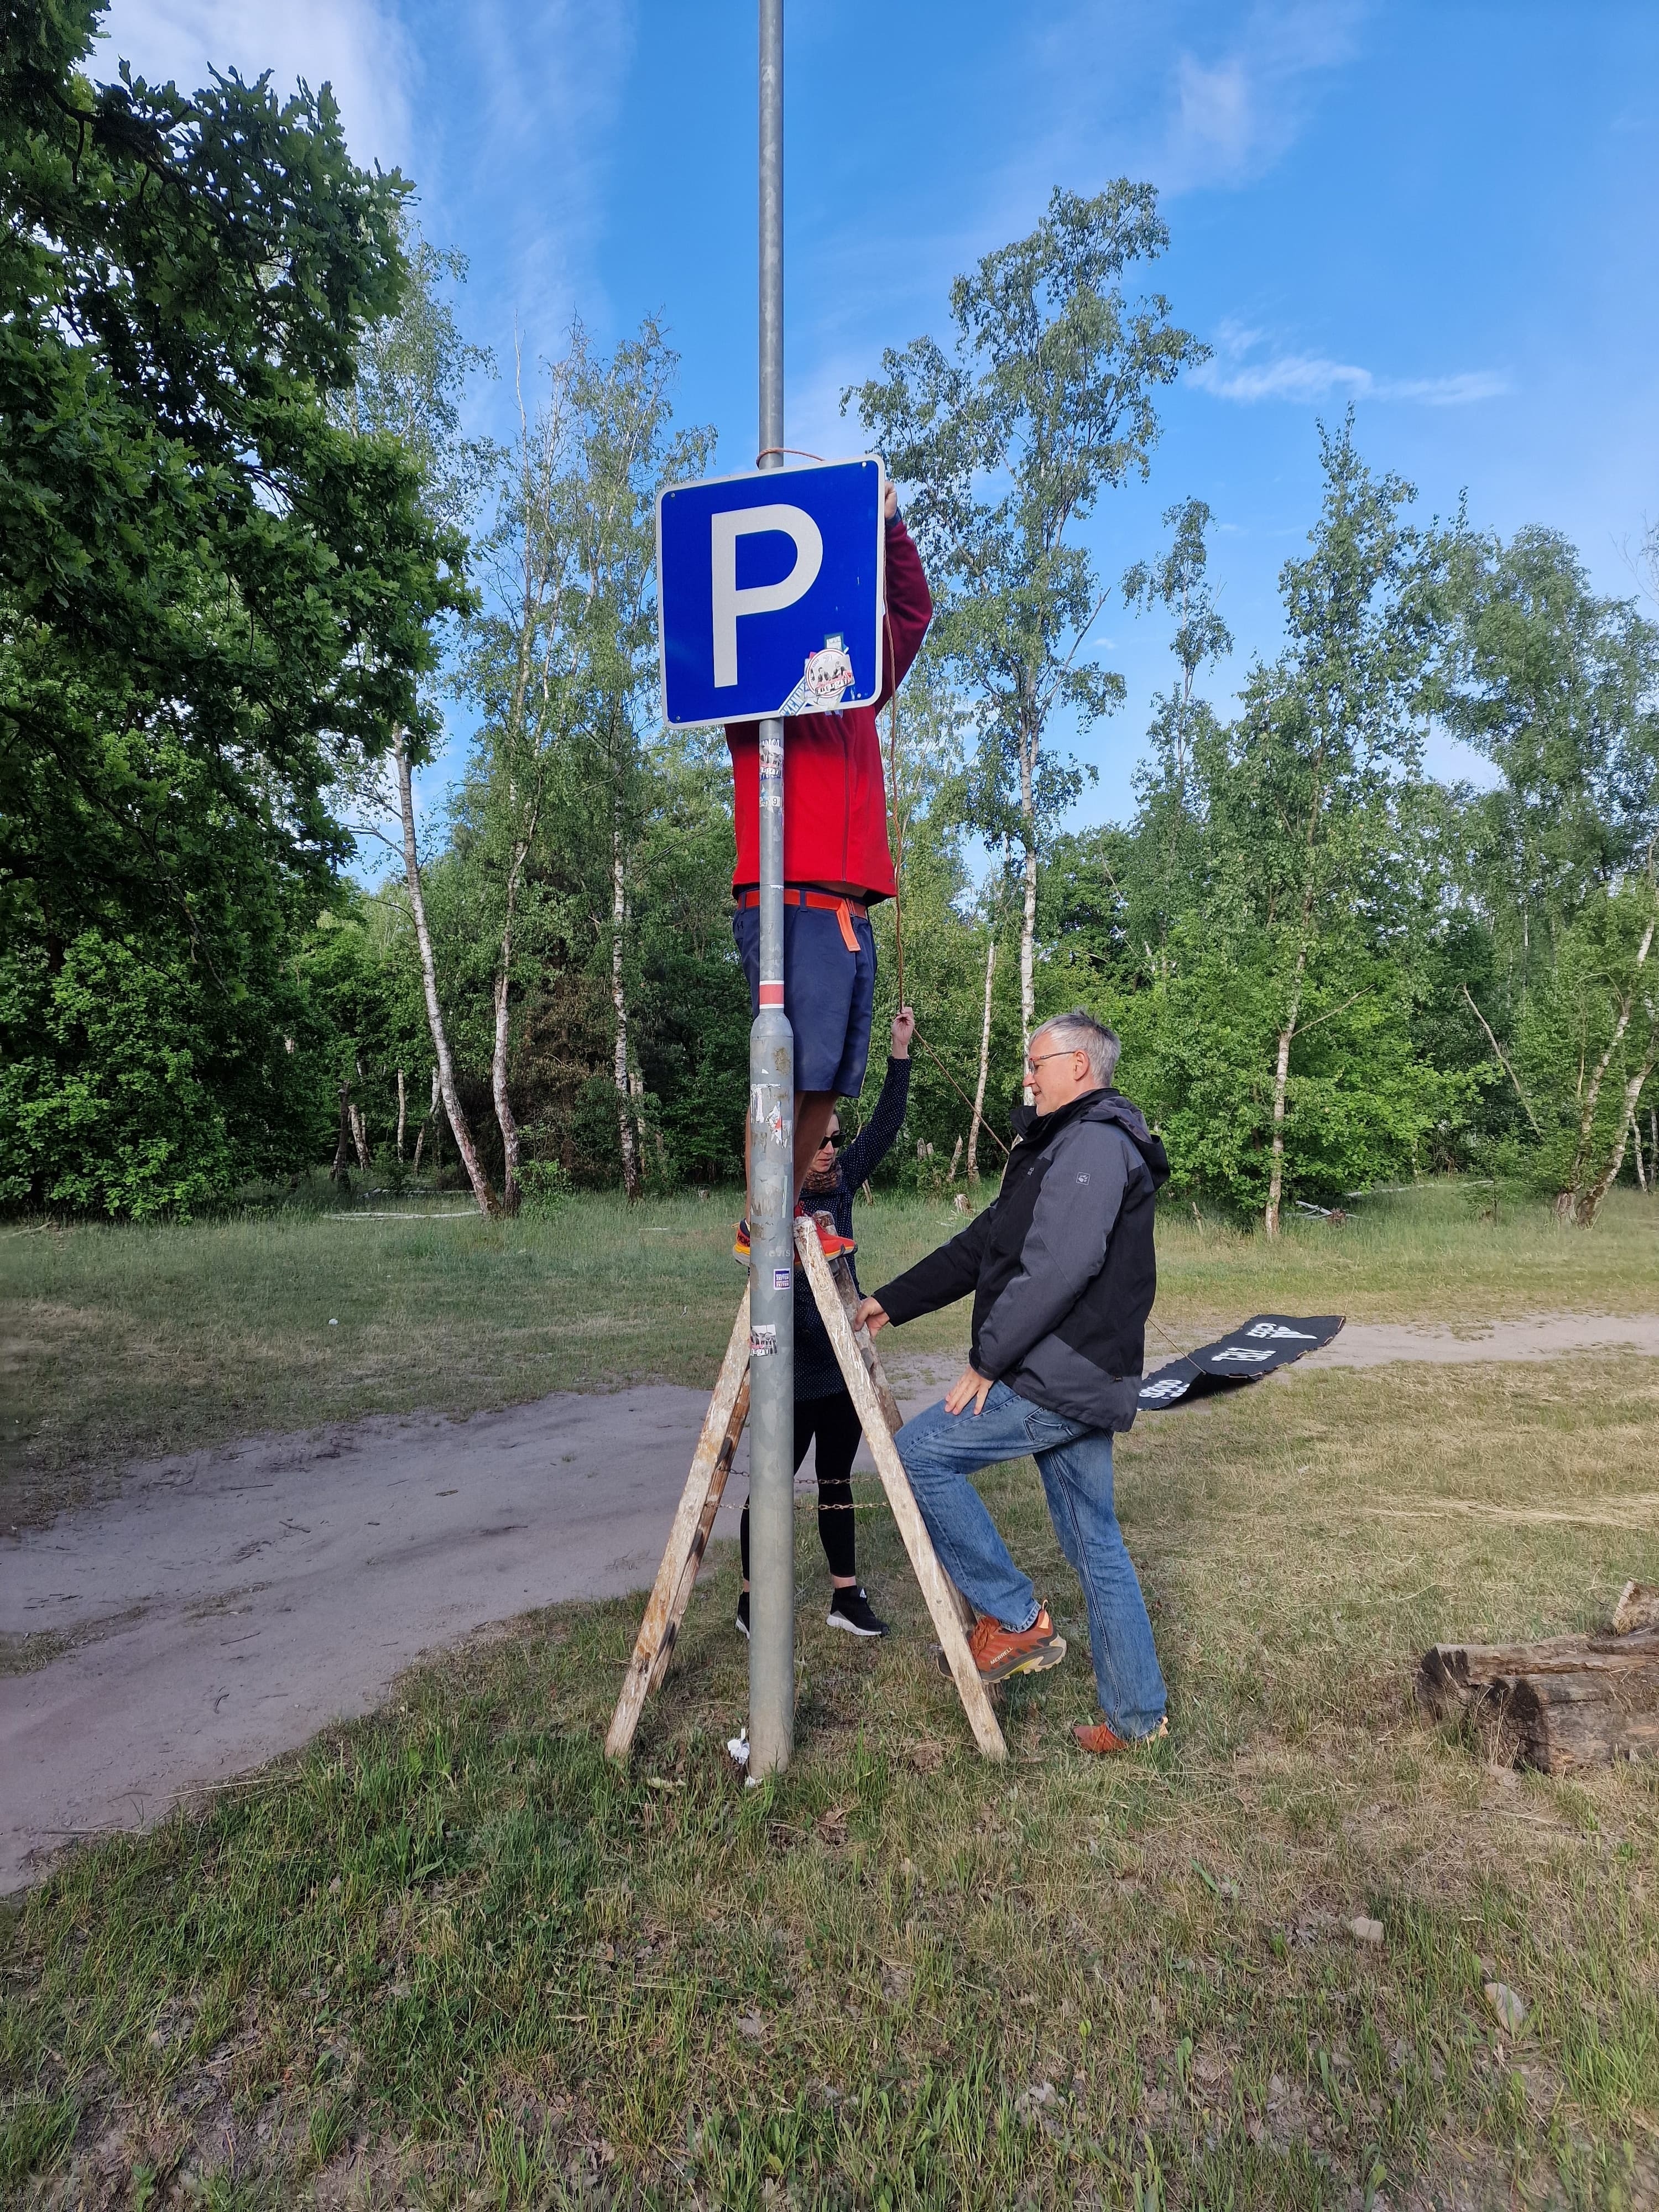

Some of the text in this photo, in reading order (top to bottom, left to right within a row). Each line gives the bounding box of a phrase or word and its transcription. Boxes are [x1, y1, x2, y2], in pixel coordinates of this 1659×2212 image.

[711, 503, 823, 687] P
[737, 1233, 750, 1247] HOK
[1211, 1348, 1277, 1361] ZIEL
[990, 1647, 1014, 1665] MERRELL
